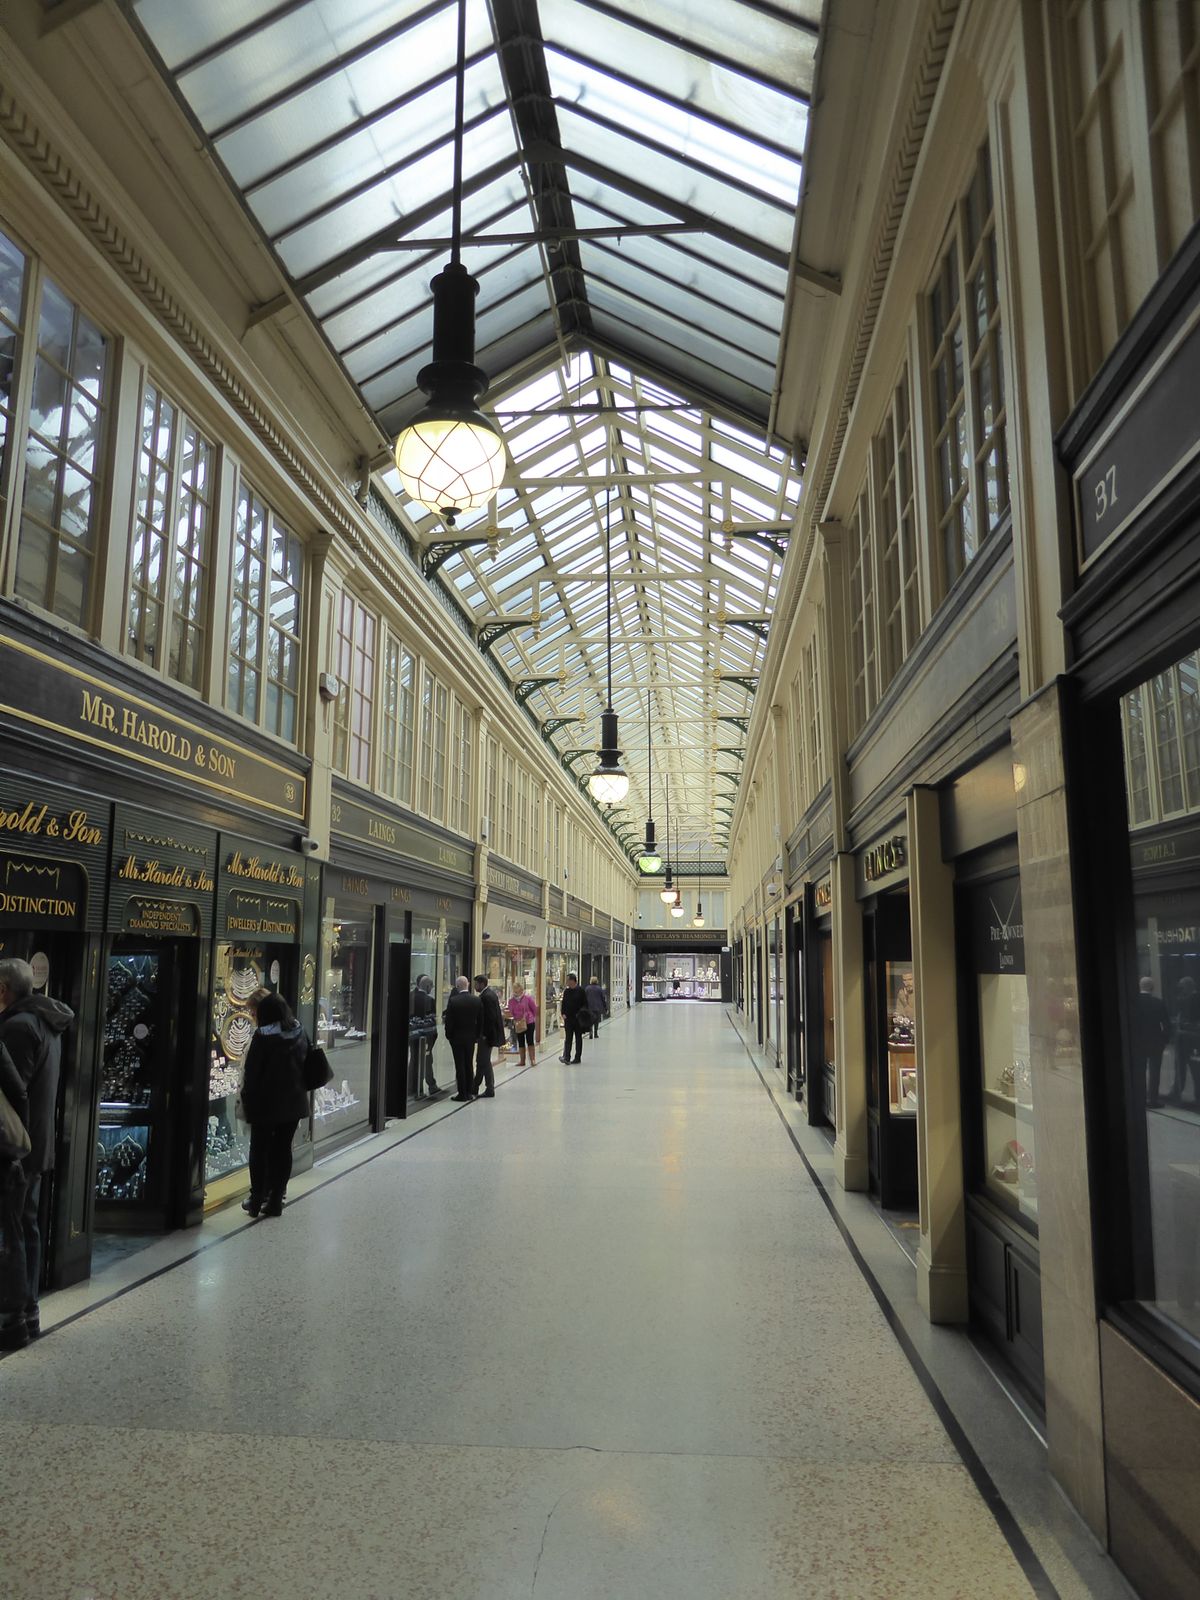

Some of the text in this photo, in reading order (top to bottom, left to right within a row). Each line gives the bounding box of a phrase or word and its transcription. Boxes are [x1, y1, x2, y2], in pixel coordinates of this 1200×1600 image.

[1094, 465, 1119, 523] 37
[80, 690, 237, 779] MR. HAROLD & SON
[285, 785, 294, 801] 33
[332, 806, 341, 822] 32
[47, 817, 59, 836] &
[63, 810, 103, 845] Son
[368, 819, 396, 844] LAINGS
[119, 855, 214, 891] Mr. Harold & Son
[227, 851, 245, 875] Mr.
[245, 856, 280, 883] Harold
[286, 865, 304, 887] Son
[129, 919, 191, 931] DIAMOND SPECIALISTS
[142, 910, 181, 920] INDEPENDENT
[227, 915, 257, 934] JEWELLERS
[263, 919, 295, 934] DISTINCTION
